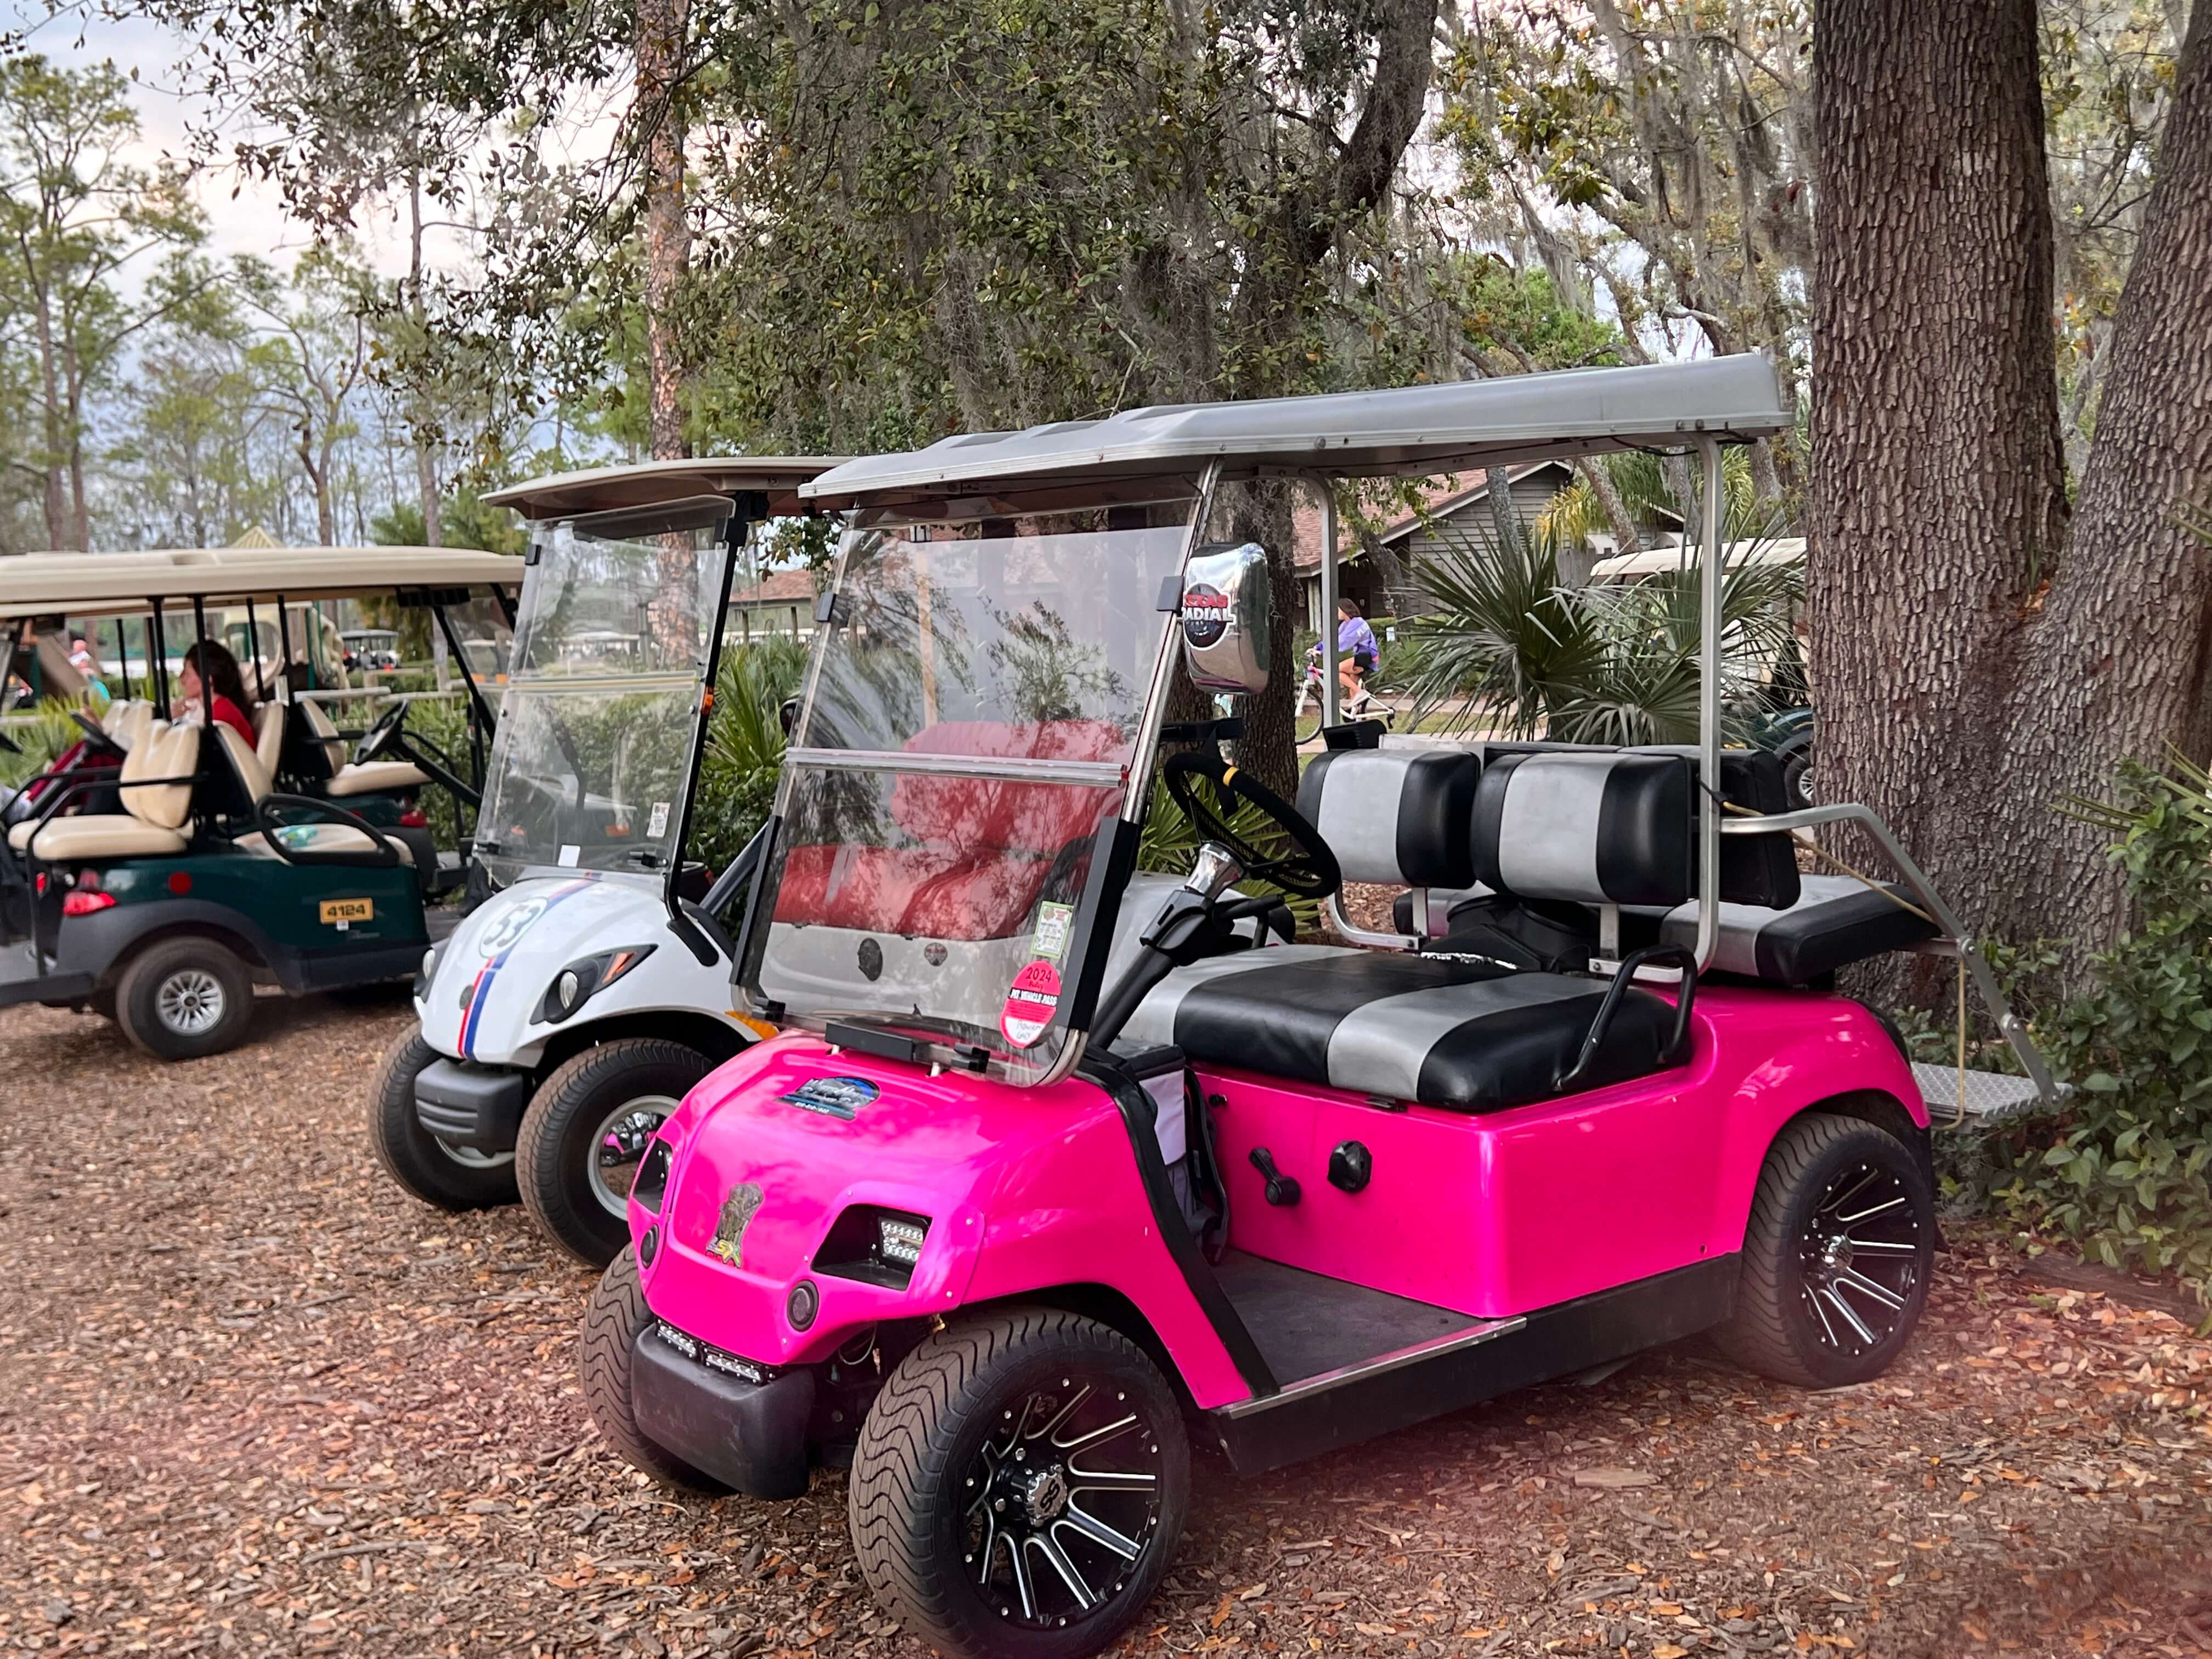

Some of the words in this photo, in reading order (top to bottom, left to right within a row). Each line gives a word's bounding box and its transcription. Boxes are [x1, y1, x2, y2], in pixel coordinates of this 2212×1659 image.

[328, 904, 365, 916] 4124
[483, 905, 540, 947] 53
[1026, 967, 1052, 983] 2024
